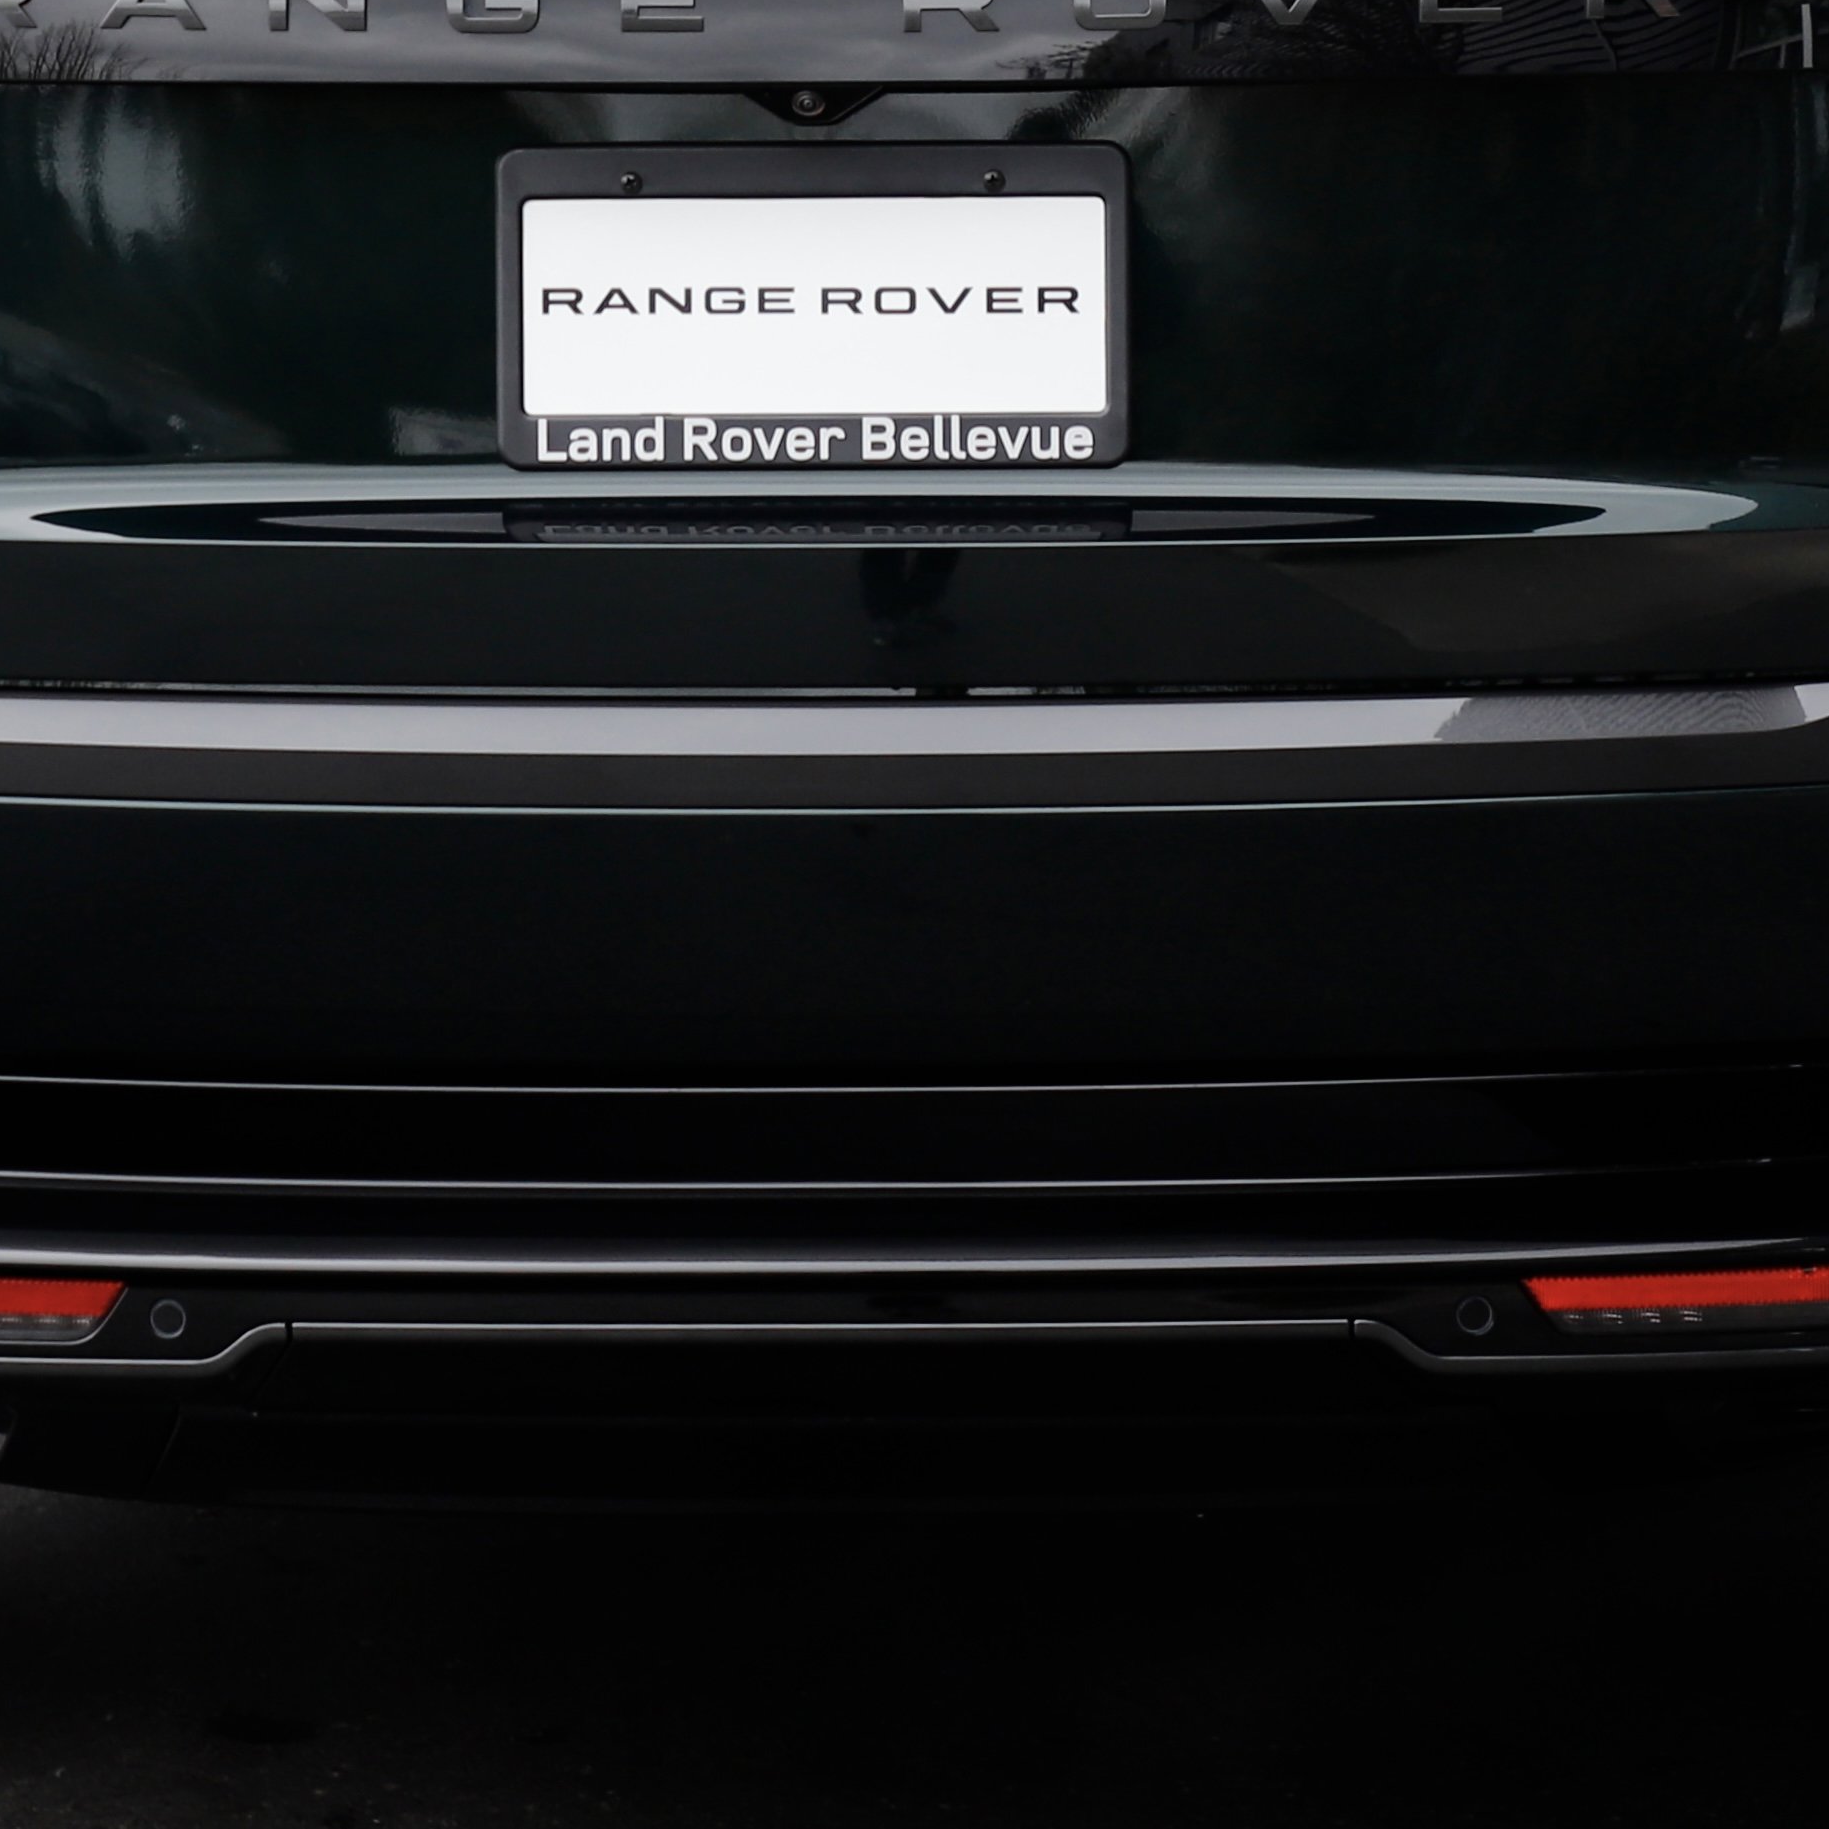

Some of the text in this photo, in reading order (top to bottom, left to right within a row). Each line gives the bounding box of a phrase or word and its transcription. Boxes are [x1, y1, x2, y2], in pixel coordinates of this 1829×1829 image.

[542, 286, 1079, 315] RANGE ROVER
[536, 414, 1095, 463] Land Rover Bellevue
